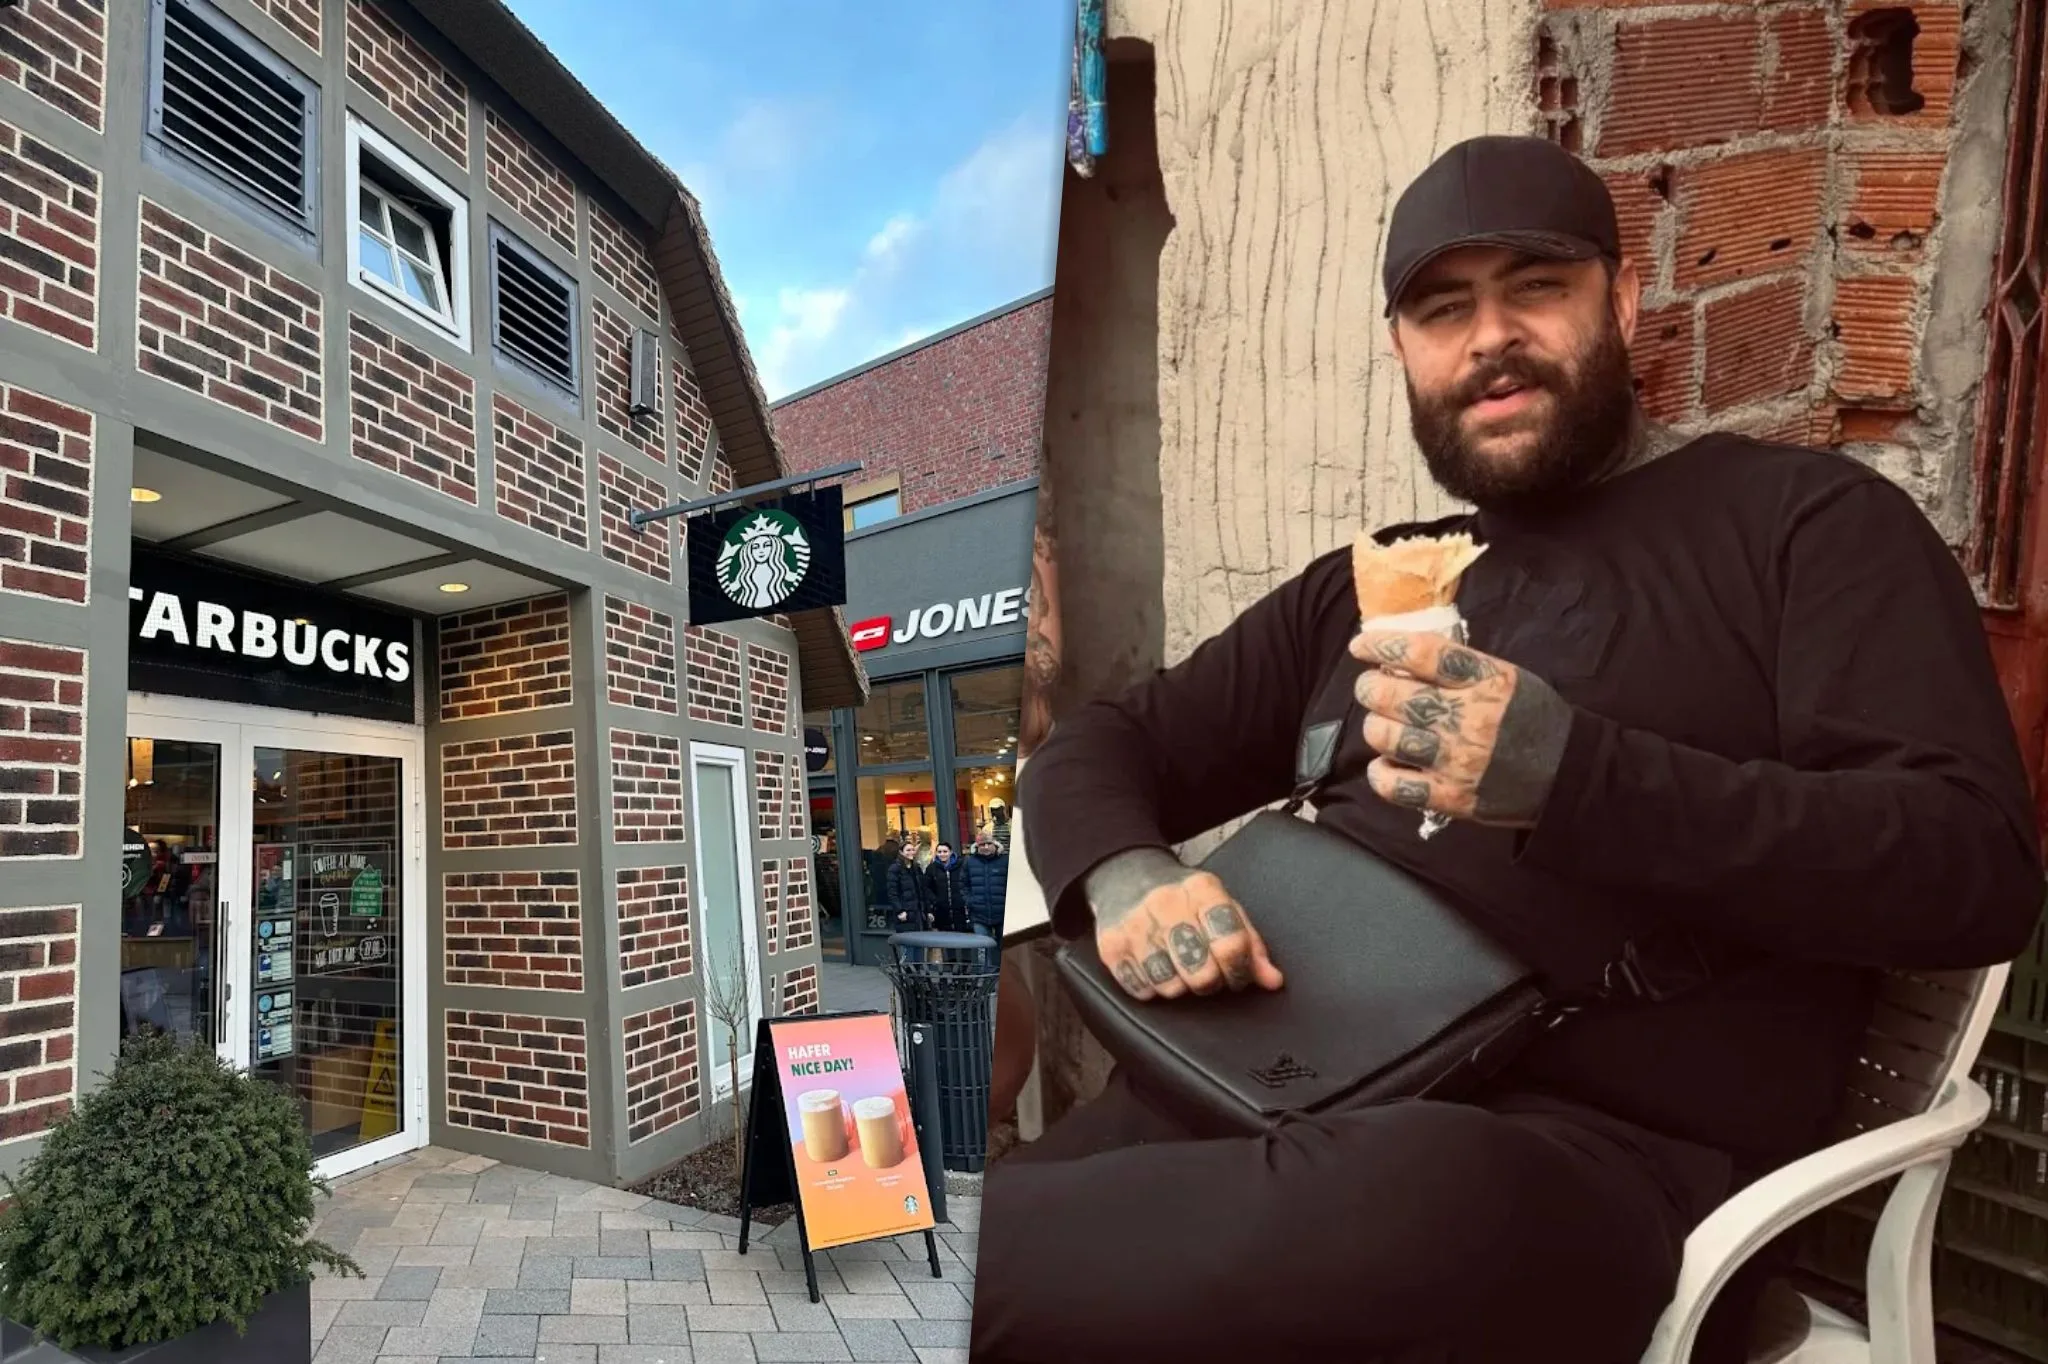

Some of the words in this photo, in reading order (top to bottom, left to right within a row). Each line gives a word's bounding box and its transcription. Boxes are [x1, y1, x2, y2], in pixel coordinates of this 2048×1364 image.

[868, 915, 887, 928] 26
[787, 1043, 831, 1061] HAFER
[791, 1061, 821, 1077] NICE
[823, 1057, 854, 1074] DAY!
